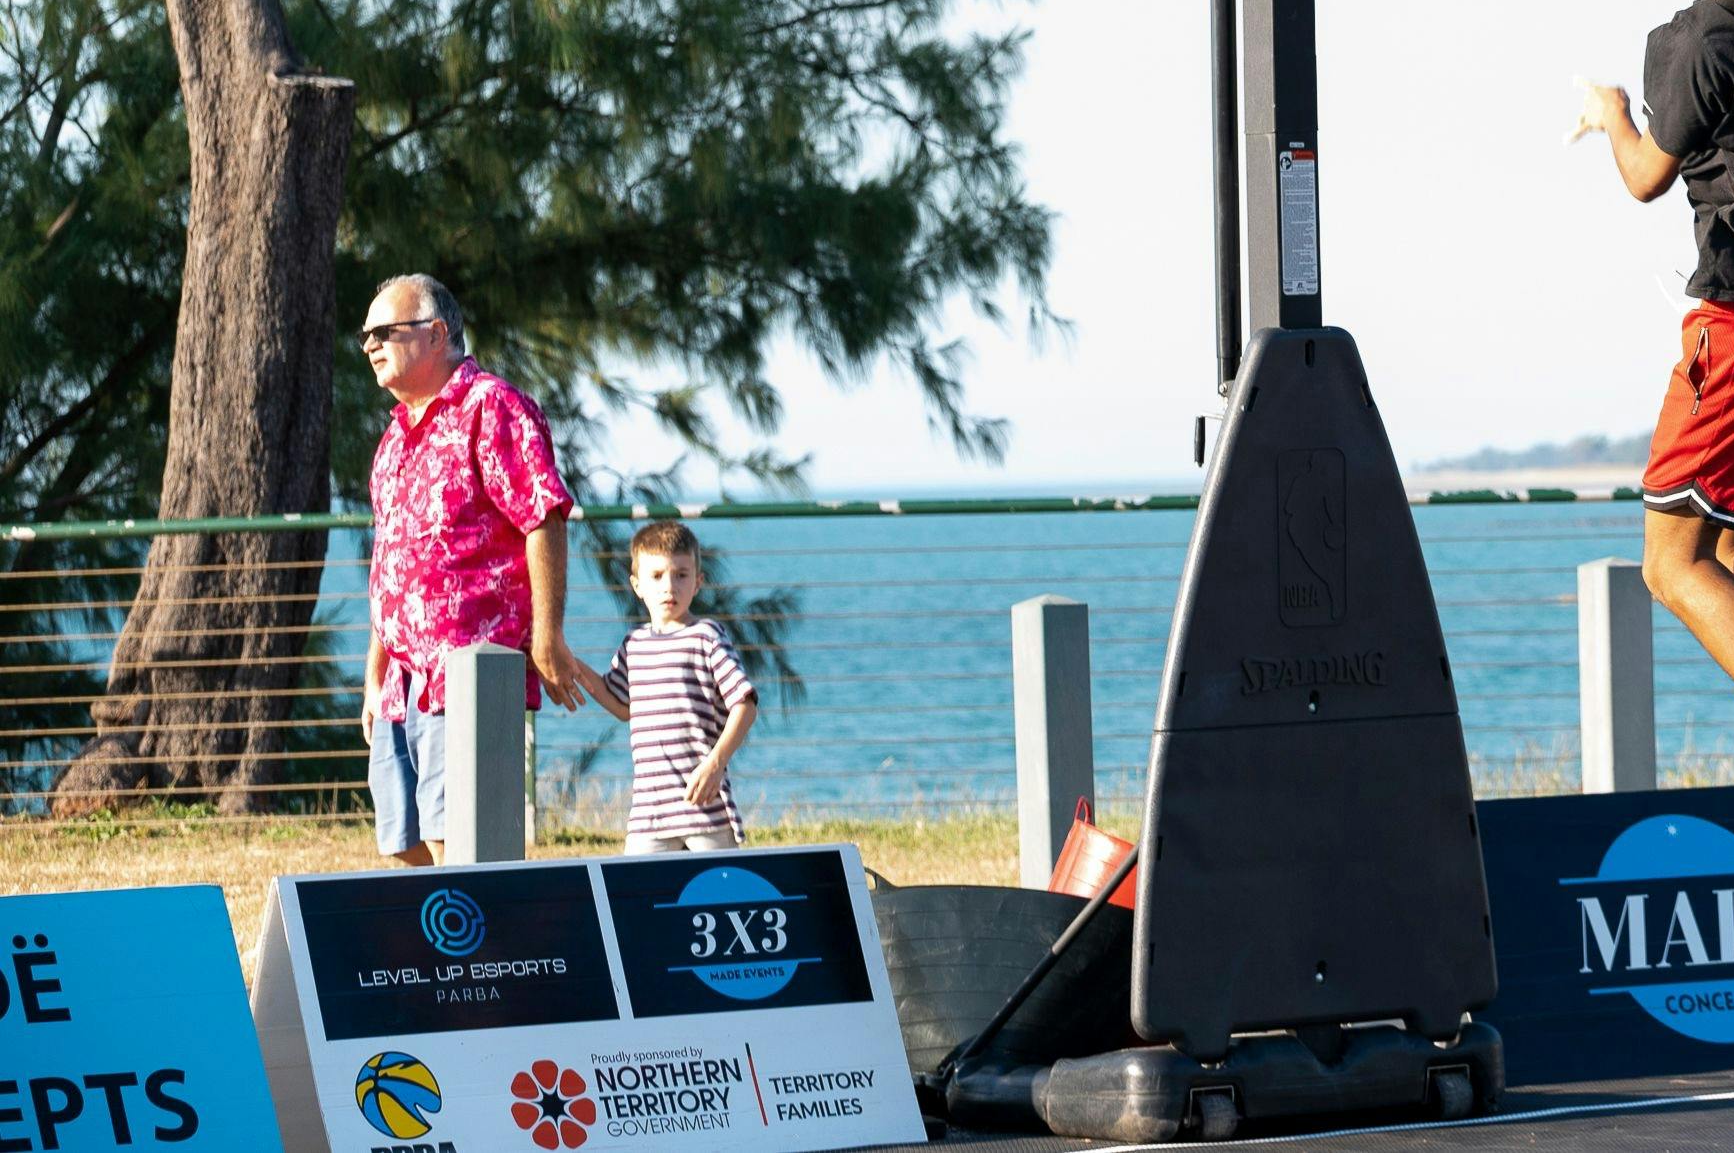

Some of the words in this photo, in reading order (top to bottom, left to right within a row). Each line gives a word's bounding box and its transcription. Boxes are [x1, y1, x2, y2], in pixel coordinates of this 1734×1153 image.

[1240, 650, 1389, 696] SPALDING
[690, 908, 787, 957] 3X3
[0, 933, 72, 1023] Ë
[358, 968, 430, 987] LEVEL
[436, 965, 464, 982] UP
[470, 958, 566, 980] ESPORTS
[709, 969, 740, 982] MADE
[743, 966, 785, 980] EVENTS
[436, 986, 500, 1004] PARBA
[591, 1050, 631, 1065] Proudly
[633, 1046, 688, 1062] sponsored
[690, 1047, 703, 1059] by
[594, 1058, 742, 1092] NORTHERN
[769, 1070, 875, 1094] TERRITORY
[599, 1087, 730, 1119] TERRITORY
[776, 1098, 863, 1121] FAMILIES
[607, 1112, 731, 1137] GOVERNMENT
